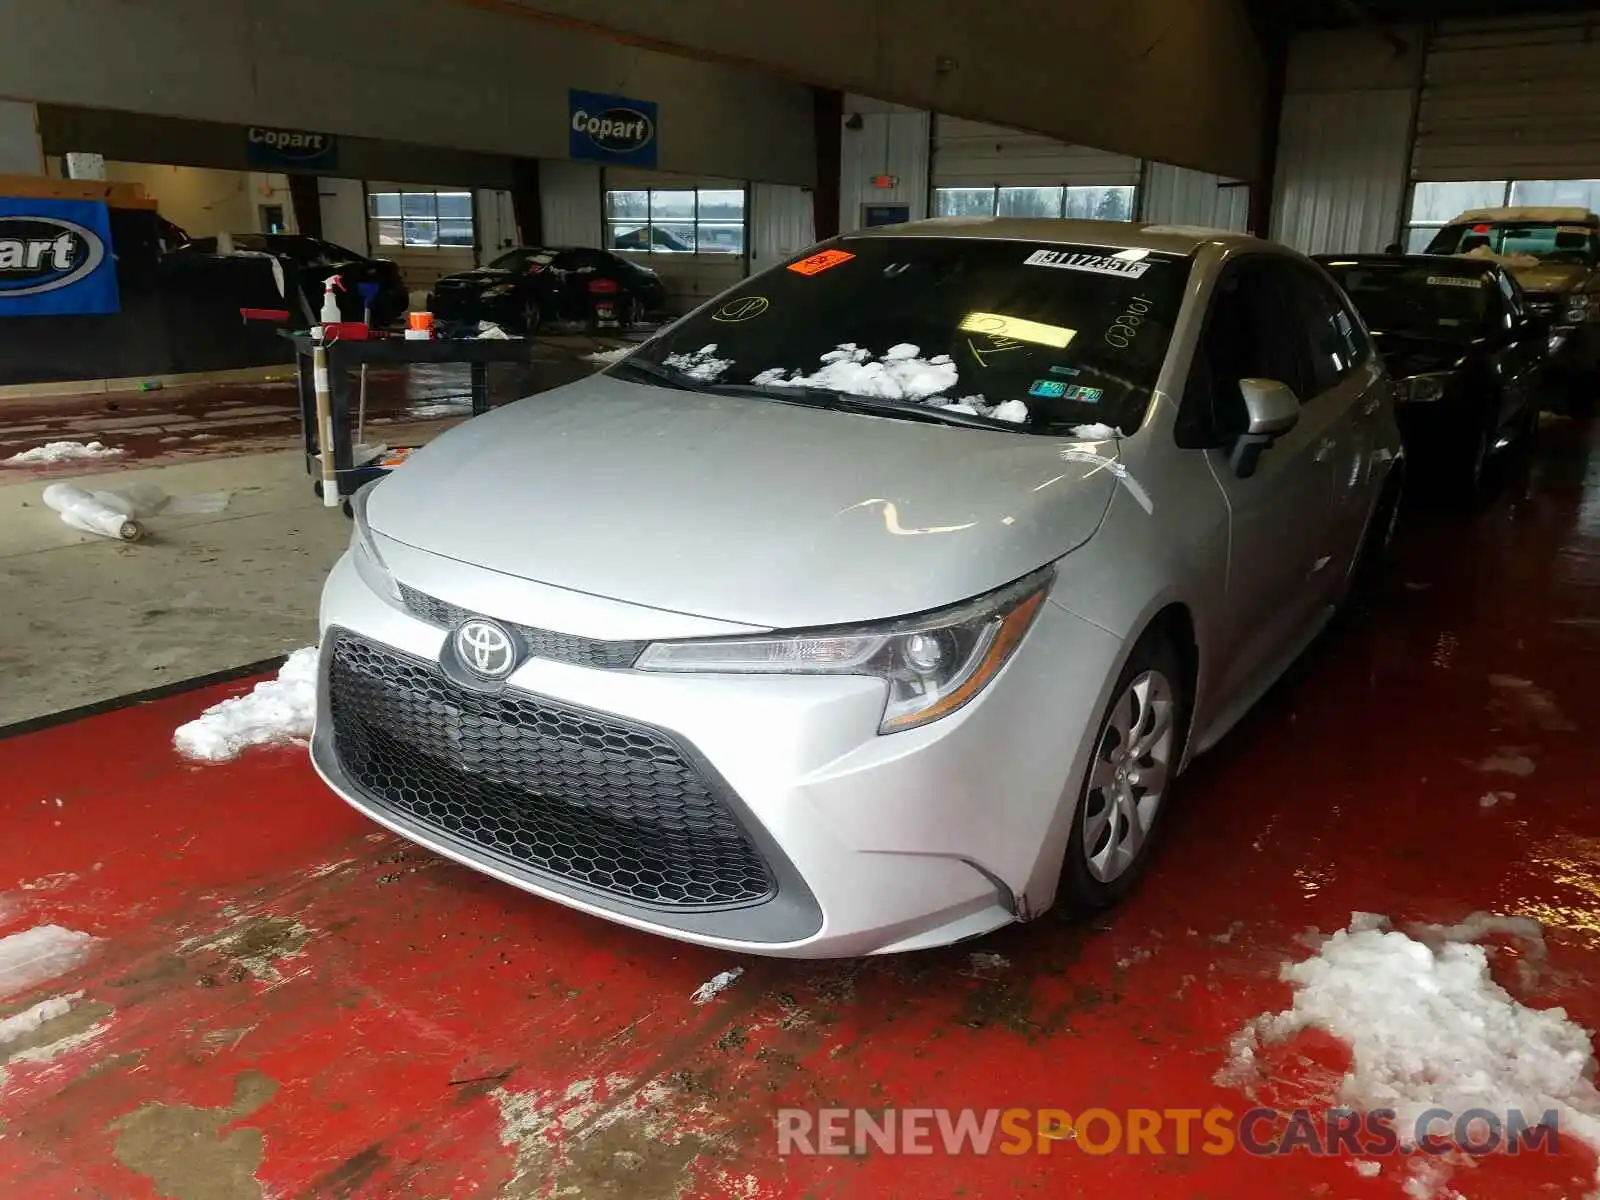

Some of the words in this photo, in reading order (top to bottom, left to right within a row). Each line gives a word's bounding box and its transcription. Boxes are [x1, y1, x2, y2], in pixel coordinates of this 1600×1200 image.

[573, 110, 644, 140] Copart
[249, 127, 323, 149] Copart
[1043, 251, 1134, 273] 31172351
